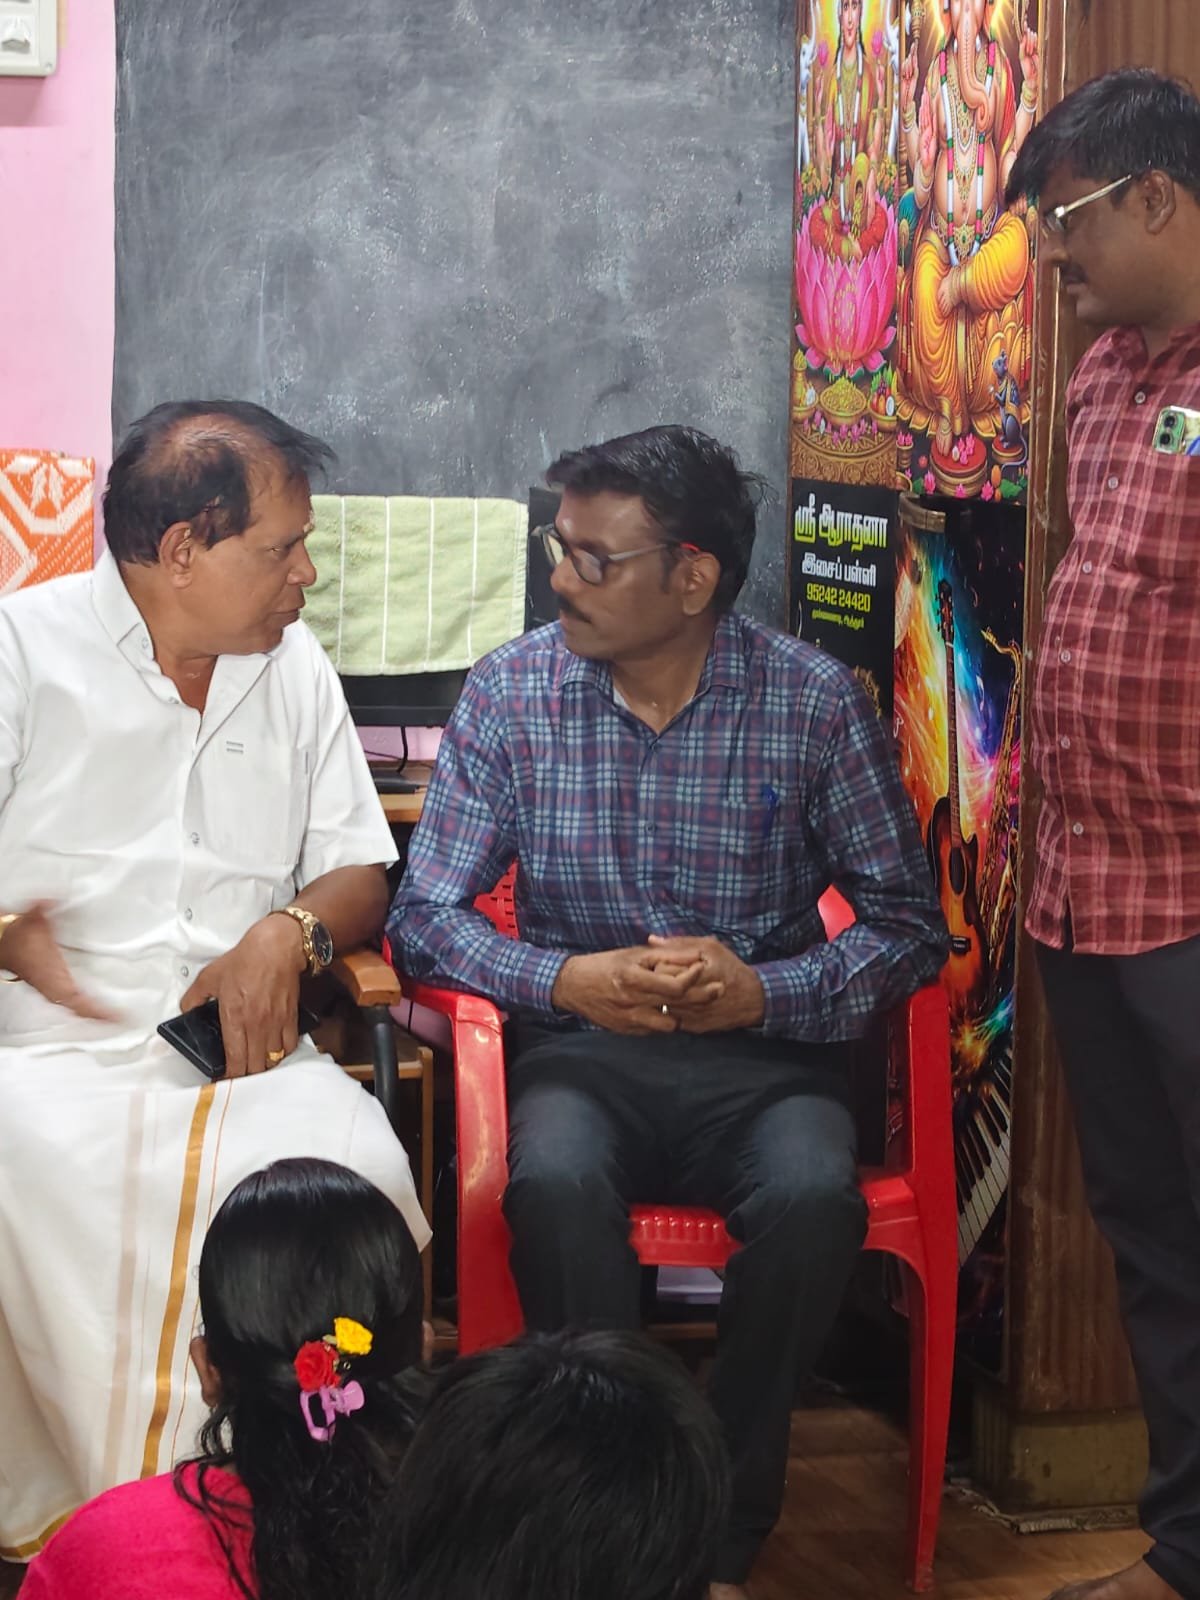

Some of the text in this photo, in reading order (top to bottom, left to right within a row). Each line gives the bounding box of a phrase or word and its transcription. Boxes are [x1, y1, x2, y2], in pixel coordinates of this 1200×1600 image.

[818, 503, 888, 552] ஆராதனா
[802, 552, 877, 587] இசைப் பள்ளி
[806, 582, 871, 612] 95242 24420
